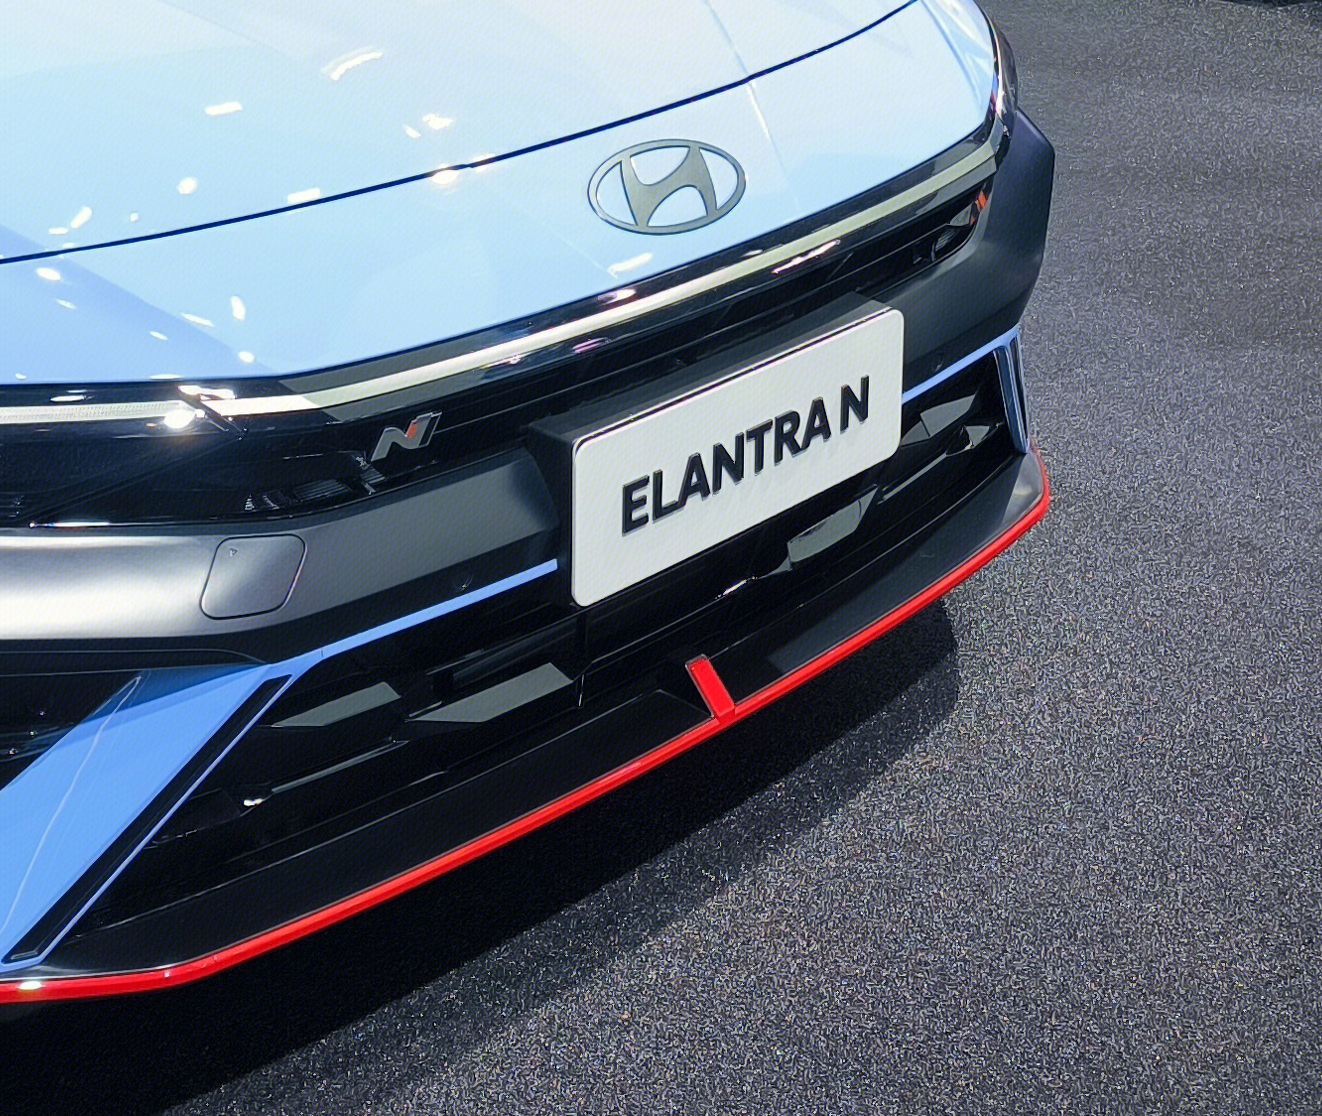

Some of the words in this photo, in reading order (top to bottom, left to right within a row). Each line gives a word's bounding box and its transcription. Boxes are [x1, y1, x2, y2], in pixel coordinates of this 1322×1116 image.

[370, 410, 442, 461] N
[622, 396, 832, 537] ELANTRA
[840, 375, 870, 434] N
